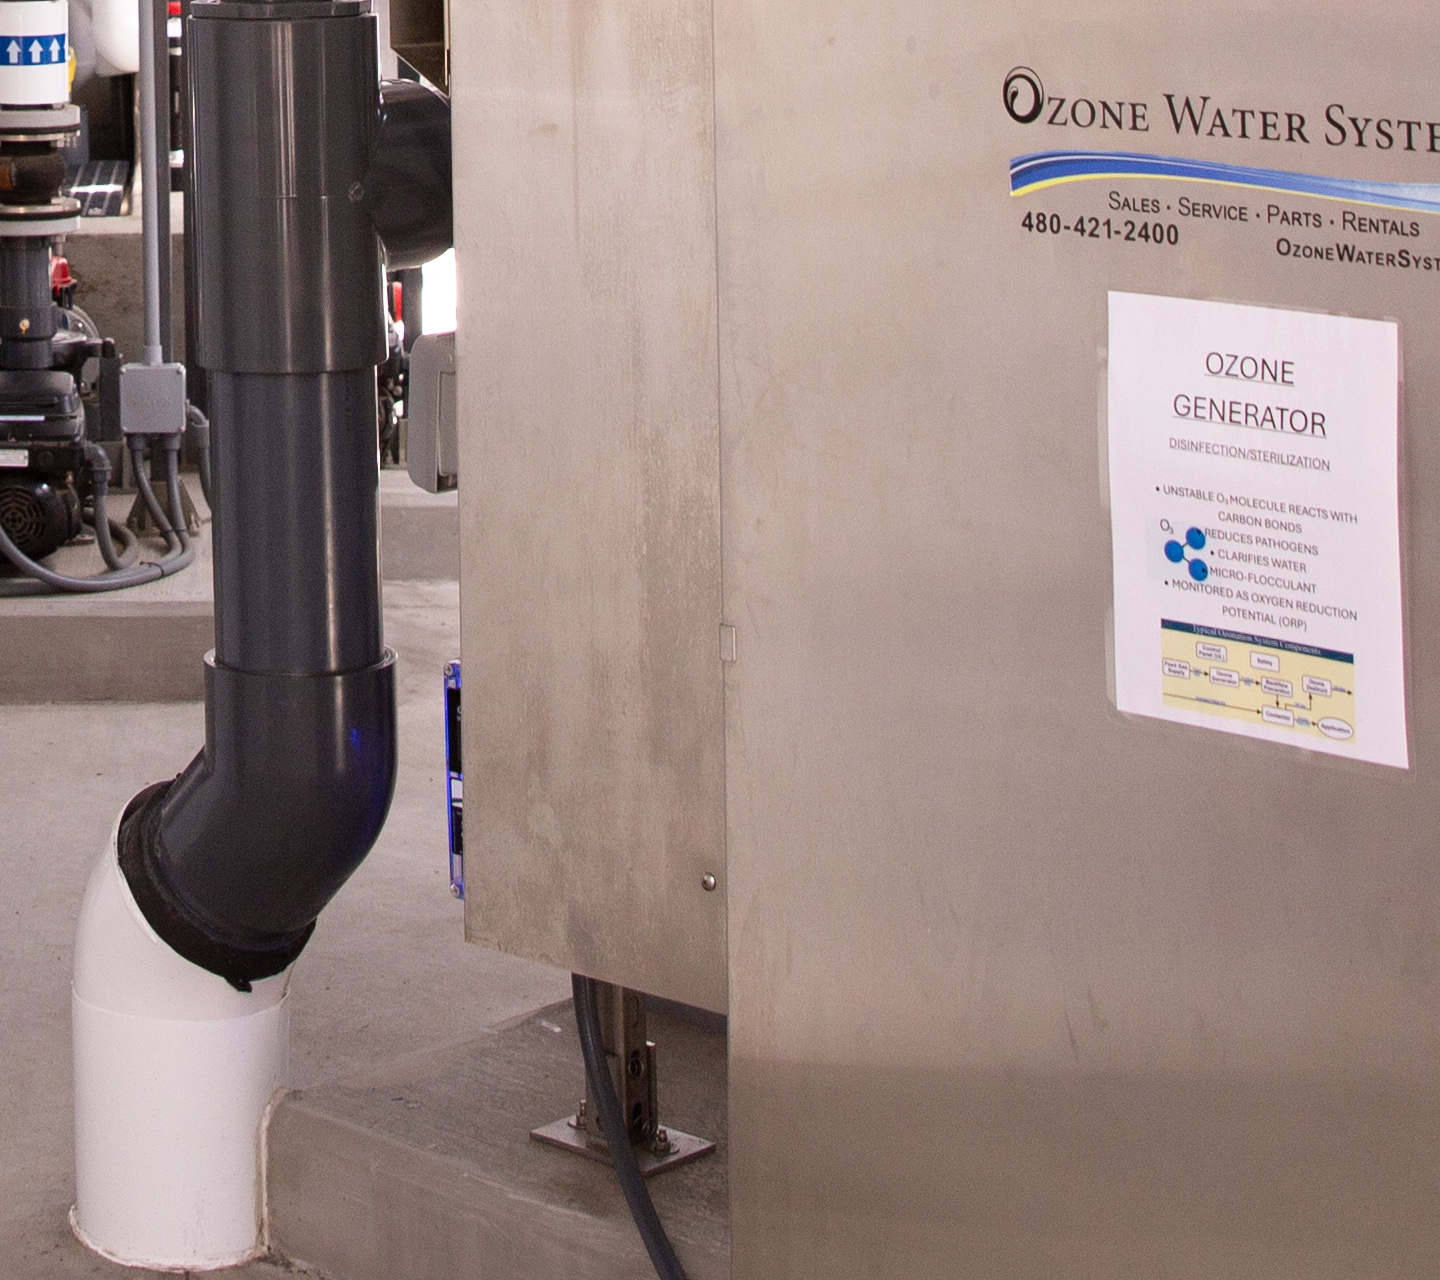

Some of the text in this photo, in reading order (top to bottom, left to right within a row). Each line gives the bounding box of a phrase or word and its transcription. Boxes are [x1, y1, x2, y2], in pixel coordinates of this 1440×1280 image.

[1021, 211, 1180, 246] 480-421-2400
[1205, 351, 1295, 385] OZONE
[1173, 393, 1327, 436] GENERATOR
[1168, 437, 1331, 472] DISINFECTION/STERILIZATION
[1162, 484, 1214, 502] UNSTABLE
[1229, 494, 1287, 513] MOLECULE
[1288, 503, 1329, 521] REACTS
[1330, 510, 1358, 524] WITH
[1217, 510, 1303, 534] CARBON BONDS
[1204, 527, 1319, 556] REDUCES PATHOGENS
[1217, 548, 1308, 574] CLARIFIES WATER
[1209, 566, 1318, 594] MICRO-FLOCCULANT
[1172, 578, 1358, 621] MONITORED AS OXYGEN REDUCTION
[1222, 605, 1308, 632] POTENTIAL (ORP)
